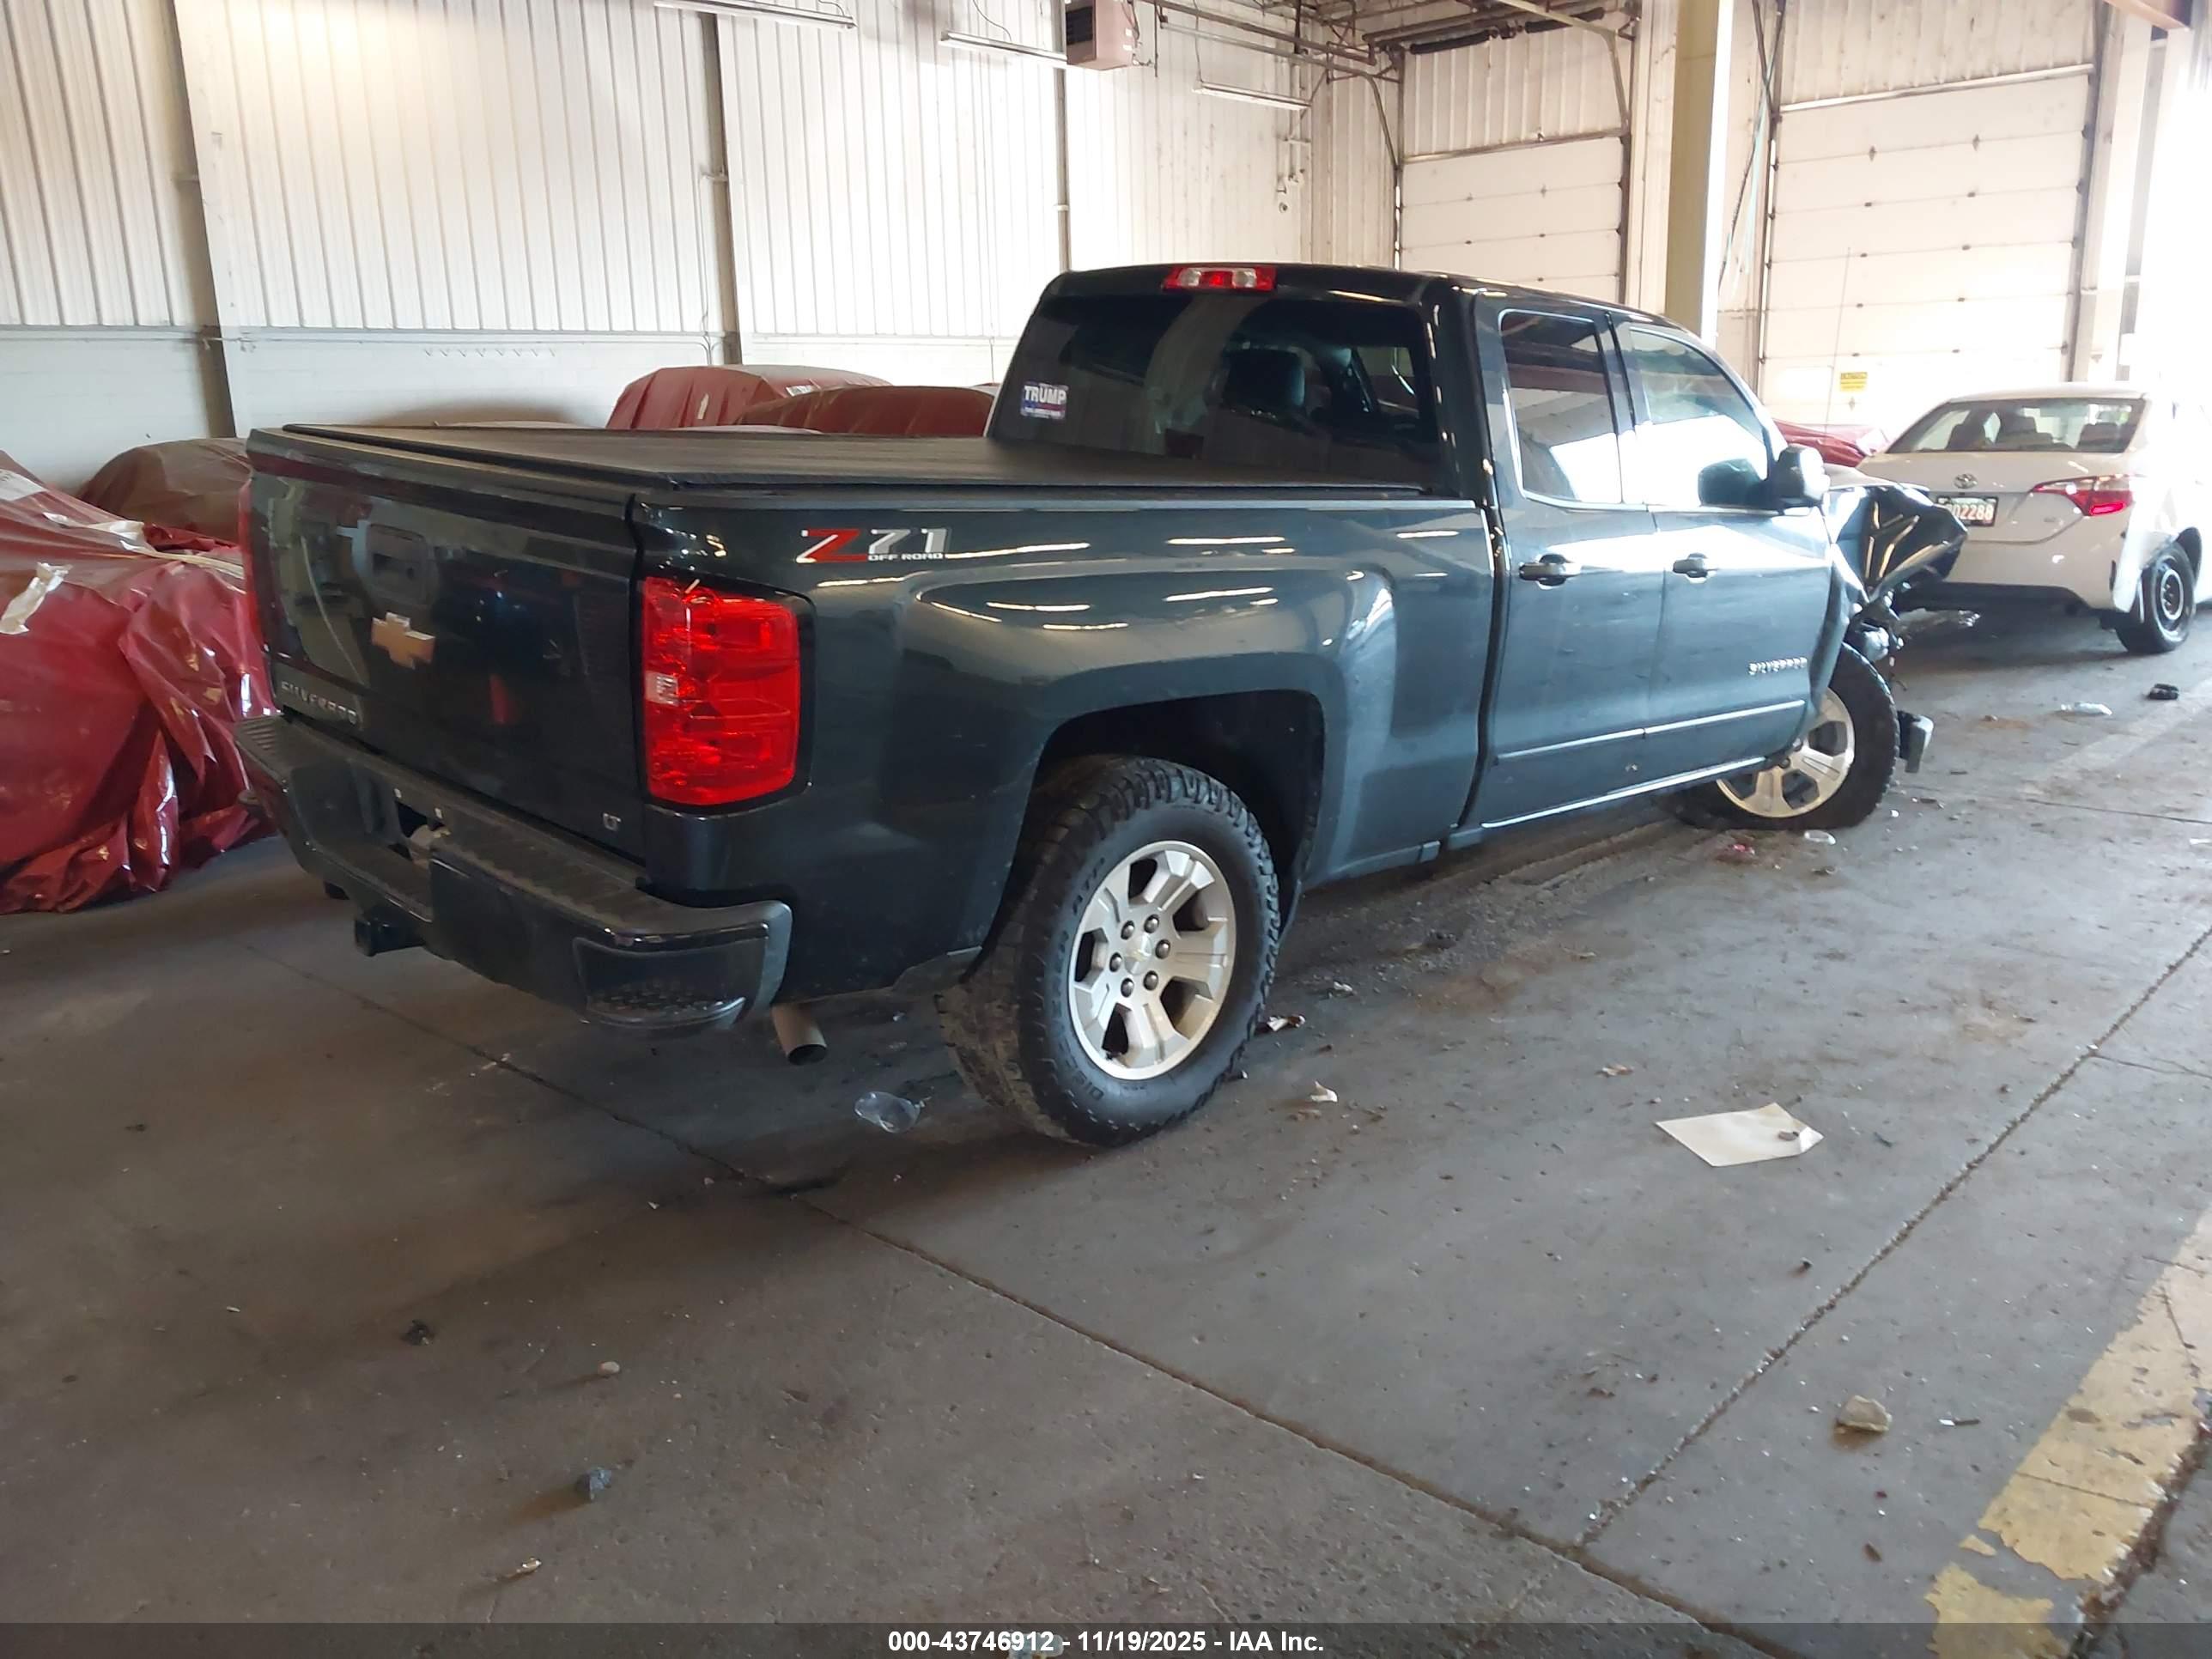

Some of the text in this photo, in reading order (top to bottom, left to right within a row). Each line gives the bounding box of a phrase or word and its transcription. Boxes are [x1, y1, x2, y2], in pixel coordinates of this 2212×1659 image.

[1024, 385, 1067, 404] TRUMP
[795, 527, 949, 563] Z71
[902, 552, 944, 561] ROAD
